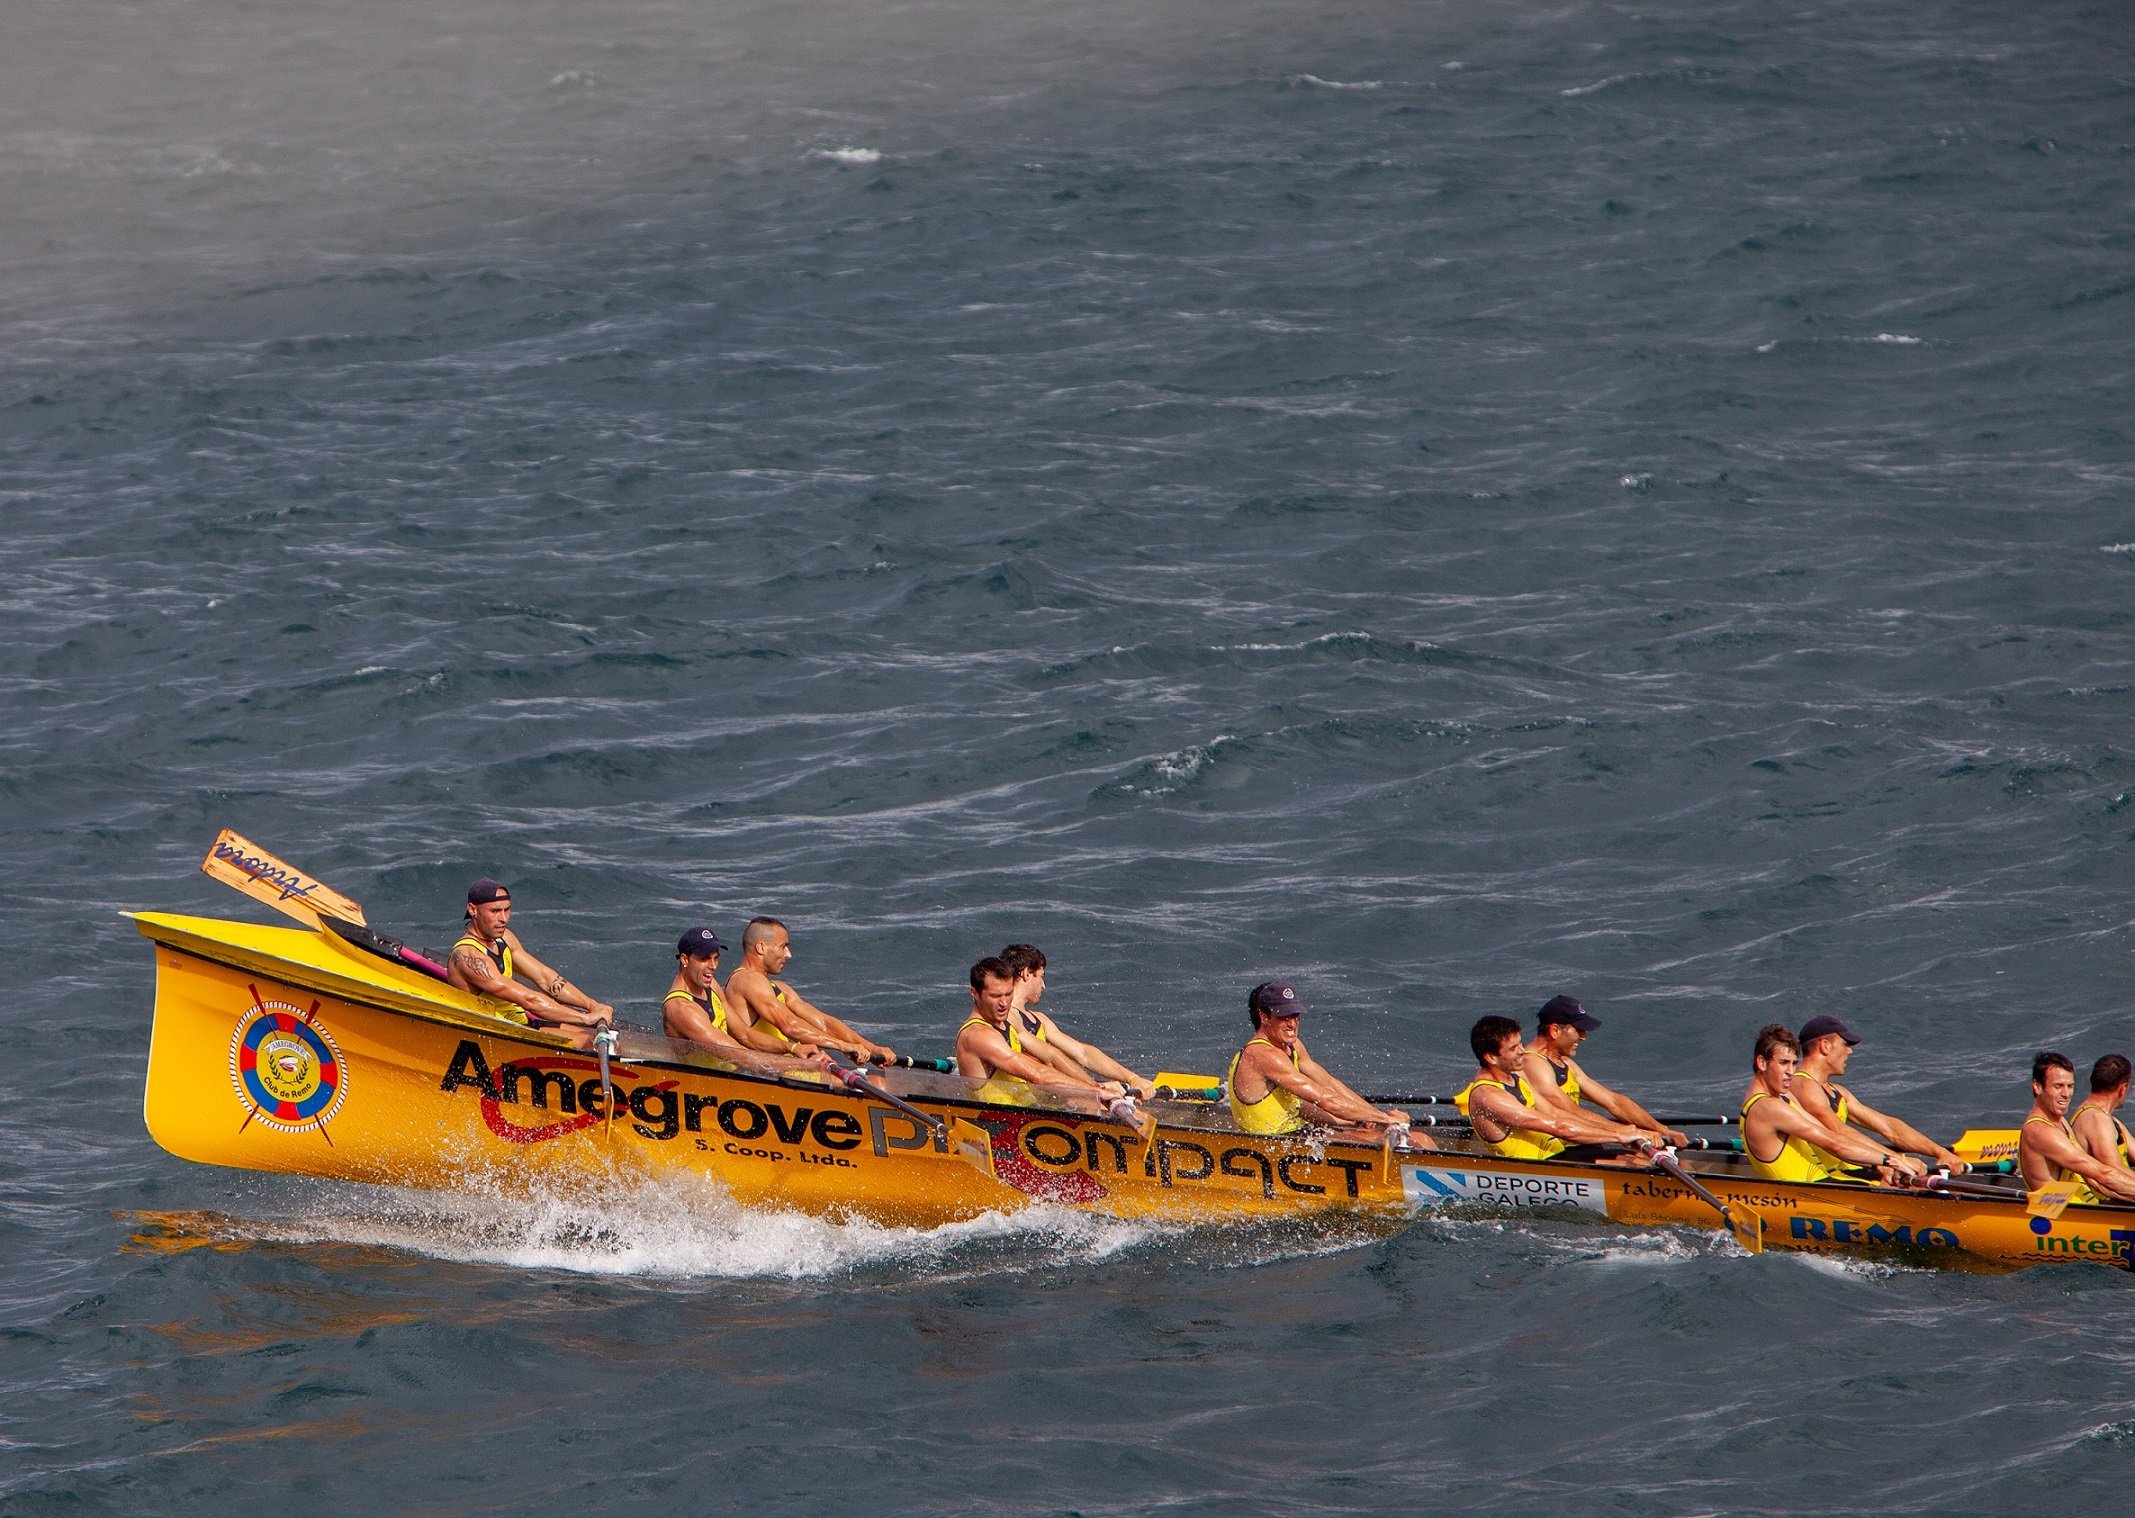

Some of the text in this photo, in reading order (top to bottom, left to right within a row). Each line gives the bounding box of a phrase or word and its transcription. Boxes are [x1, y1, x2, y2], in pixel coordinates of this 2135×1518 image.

[264, 1076, 312, 1098] Club de Remo
[440, 1039, 863, 1150] Amegrove
[694, 1138, 858, 1168] S. Coop. Ltda.
[1476, 1175, 1590, 1197] DEPORTE
[1622, 1180, 1798, 1209] tabern-mesón
[1789, 1216, 1960, 1248] REMO
